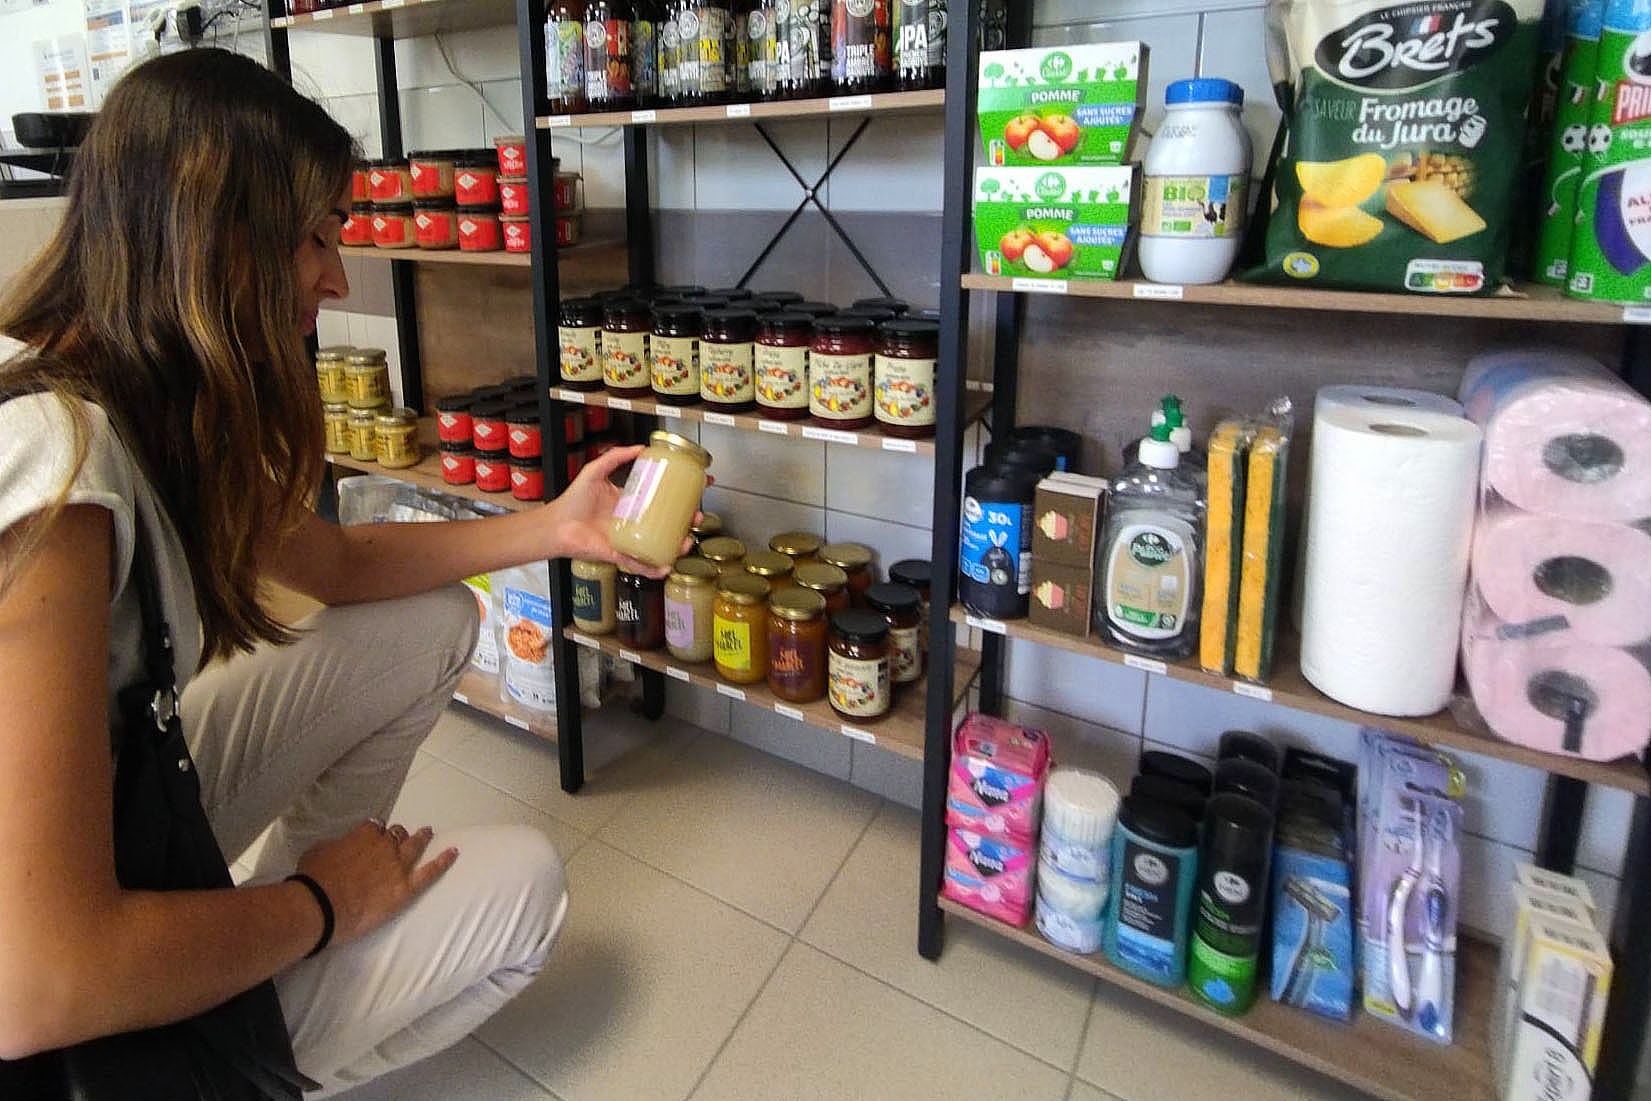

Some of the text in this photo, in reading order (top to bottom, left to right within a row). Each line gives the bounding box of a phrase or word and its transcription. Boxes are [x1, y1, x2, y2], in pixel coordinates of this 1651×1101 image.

[898, 23, 928, 51] IPA
[1338, 12, 1500, 79] Brets
[1031, 89, 1080, 104] POMME
[1076, 105, 1132, 117] SANS SUCRES
[1358, 97, 1480, 123] Fromage
[1352, 120, 1457, 150] du Jura
[1163, 185, 1206, 201] BIO
[1026, 208, 1074, 220] POMME
